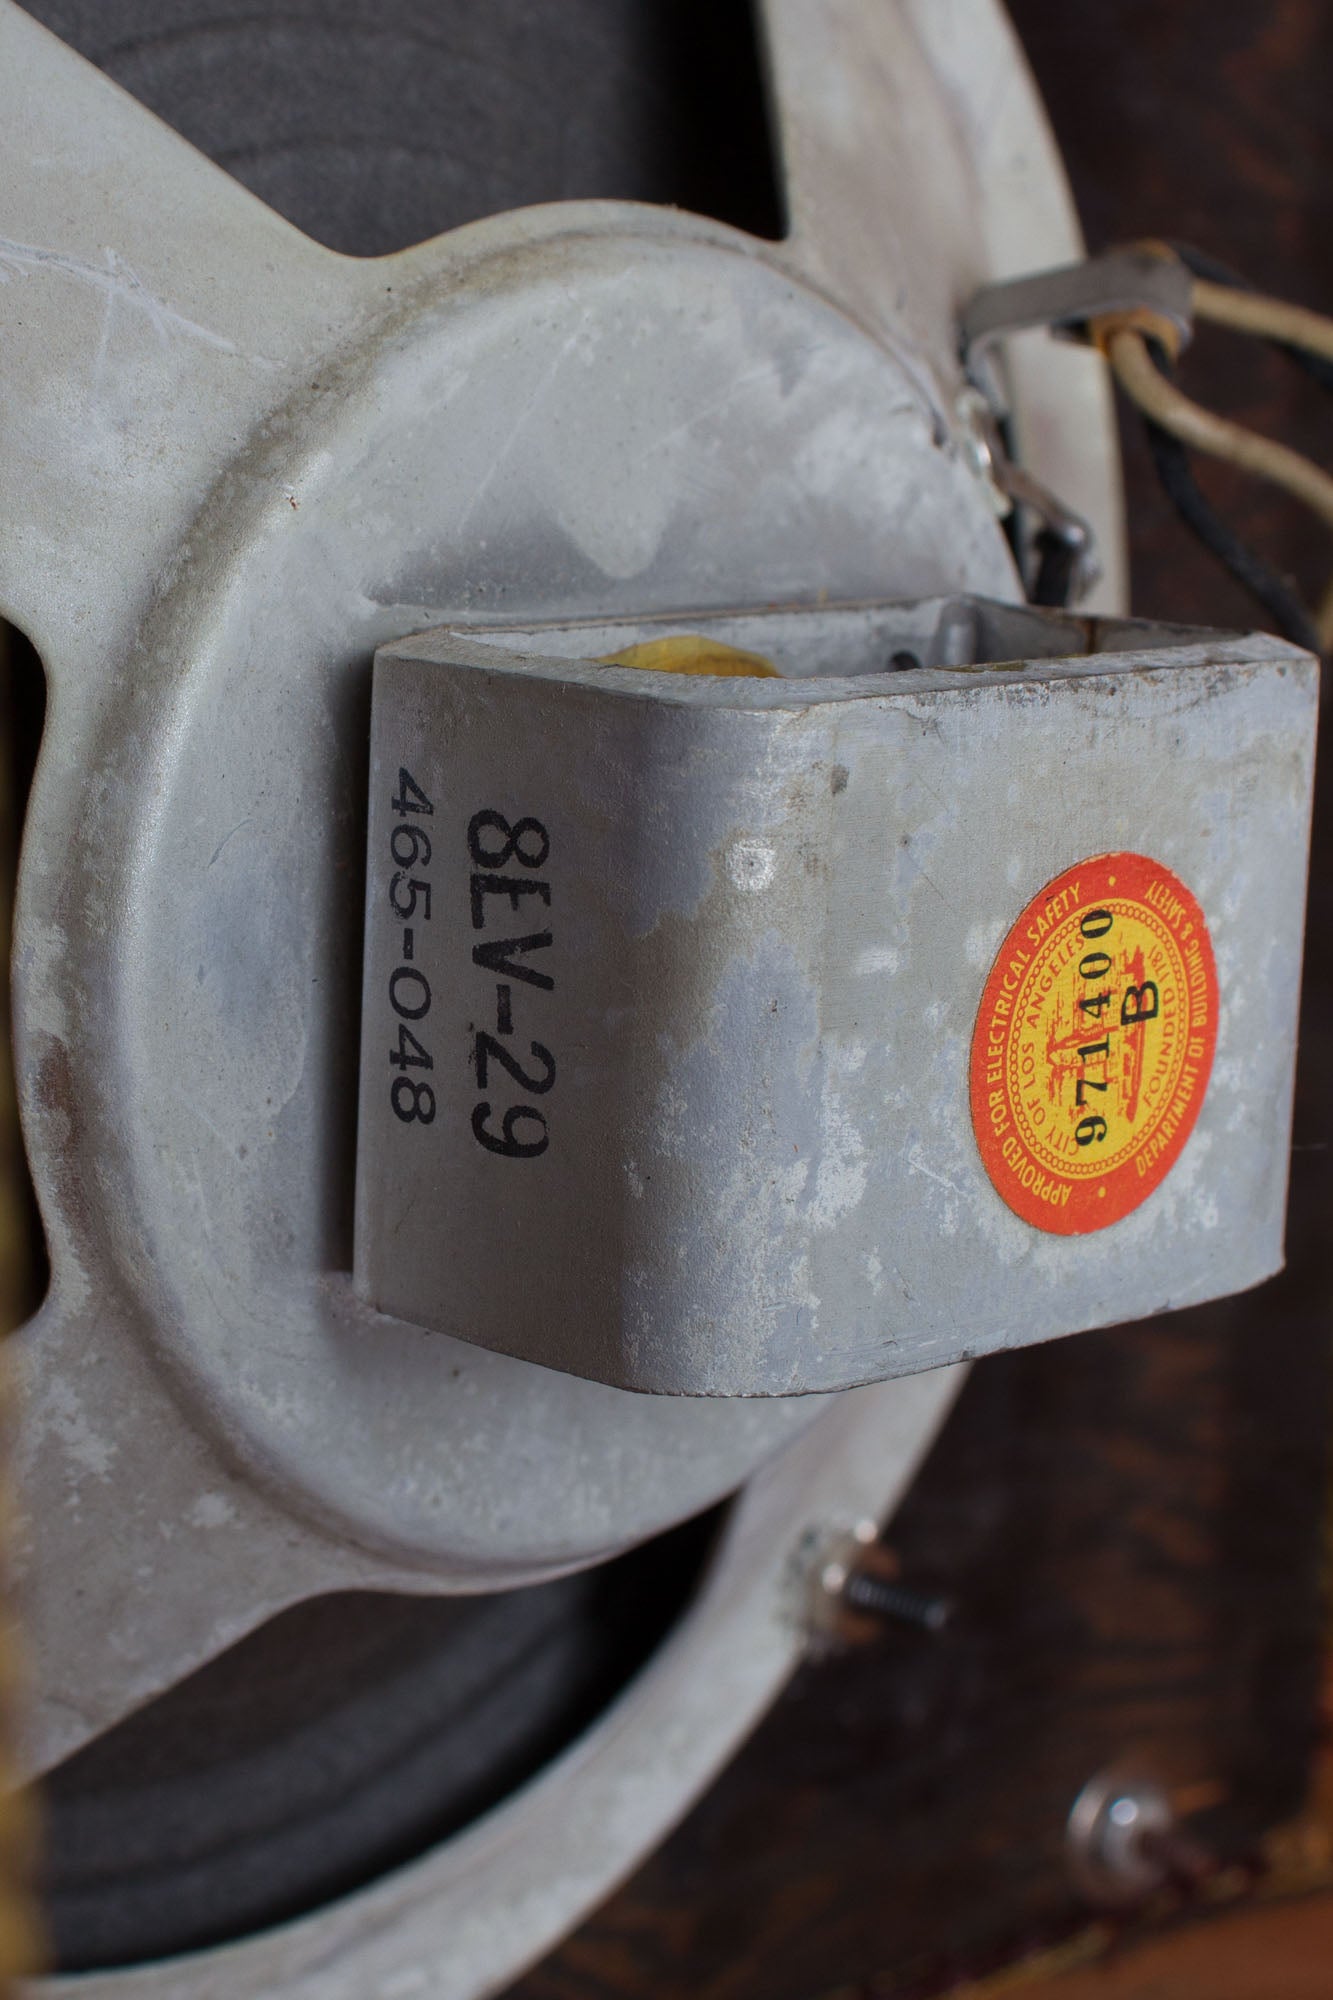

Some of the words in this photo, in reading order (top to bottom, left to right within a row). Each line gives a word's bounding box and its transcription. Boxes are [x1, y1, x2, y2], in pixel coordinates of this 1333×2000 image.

[1027, 882, 1081, 947] SAFETY
[1144, 880, 1186, 929] SAFETY
[1180, 922, 1193, 940] &
[389, 767, 435, 1125] 465-048
[1147, 944, 1170, 983] 1781
[467, 809, 556, 1159] 8EV-29
[1027, 933, 1085, 1029] ANGELES
[1121, 980, 1158, 1026] B
[1185, 939, 1208, 1027] BUILDING
[987, 949, 1031, 1084] ELECTRICAL
[1075, 909, 1113, 1146] 971400
[1143, 987, 1176, 1107] FOUNDED
[1022, 1042, 1036, 1089] LOS
[989, 1088, 1010, 1136] FOR
[1027, 1098, 1046, 1126] OF
[1046, 1125, 1080, 1156] CITY
[1135, 1064, 1198, 1177] DEPARTMENT
[1002, 1137, 1072, 1207] APPROVED
